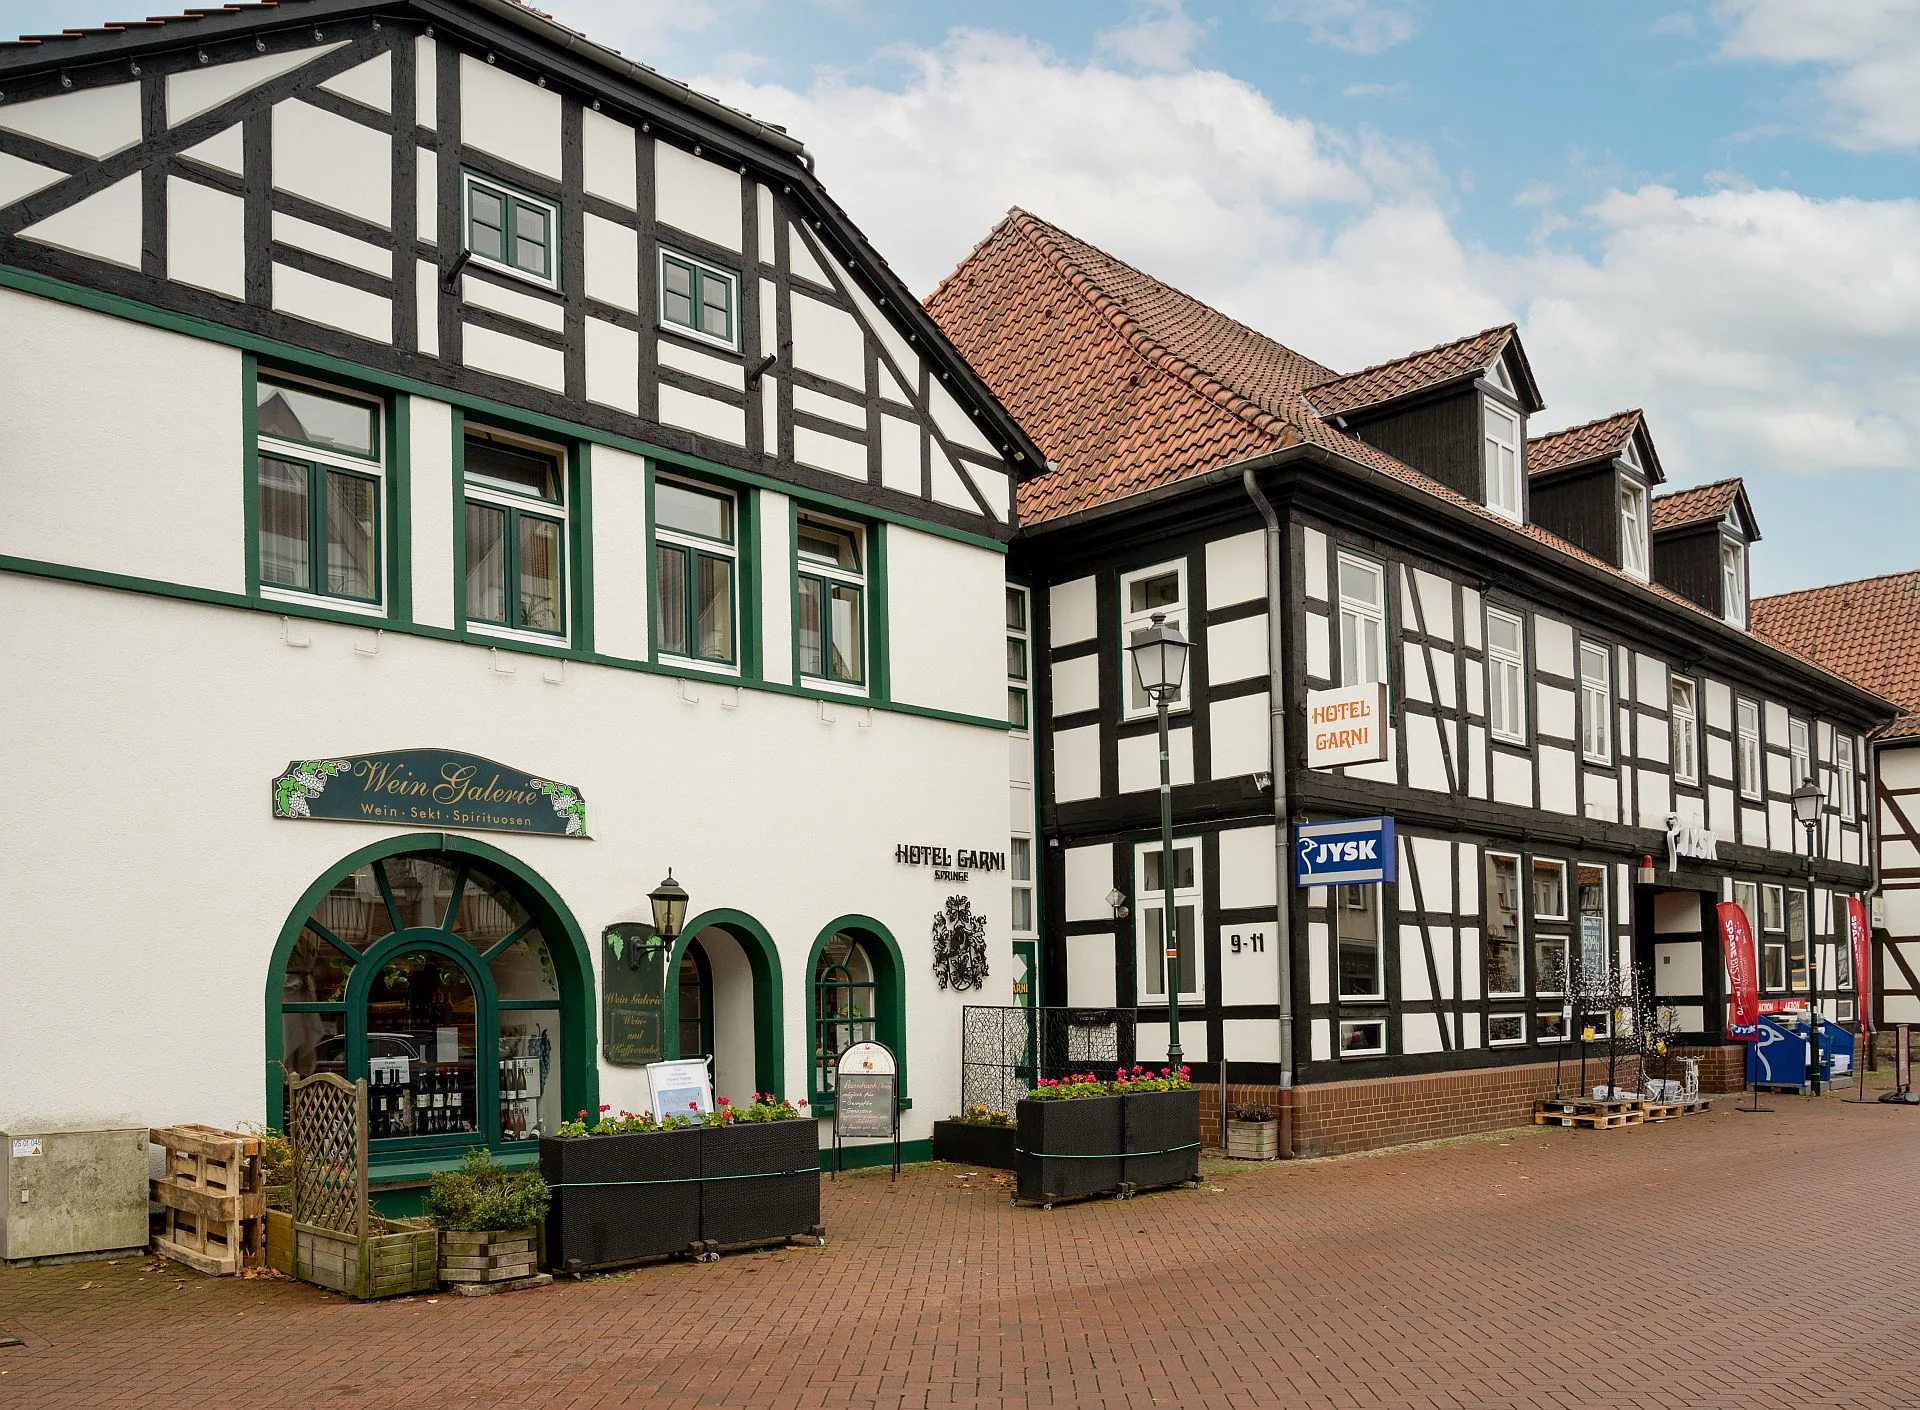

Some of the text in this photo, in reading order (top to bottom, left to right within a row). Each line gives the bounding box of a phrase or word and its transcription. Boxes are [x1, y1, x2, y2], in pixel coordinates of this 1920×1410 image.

[1312, 700, 1371, 725] HOTEL
[1315, 727, 1369, 751] GARNI
[353, 760, 538, 805] Wein Galerie
[360, 803, 532, 827] Wein Sekt Spirituosen
[895, 843, 1006, 871] HOTEL GARNI
[1315, 839, 1377, 864] JYSK
[934, 869, 969, 882] SPRINGE
[1230, 932, 1265, 953] 9-11
[1583, 935, 1600, 951] 50%
[1725, 919, 1737, 958] SPARE
